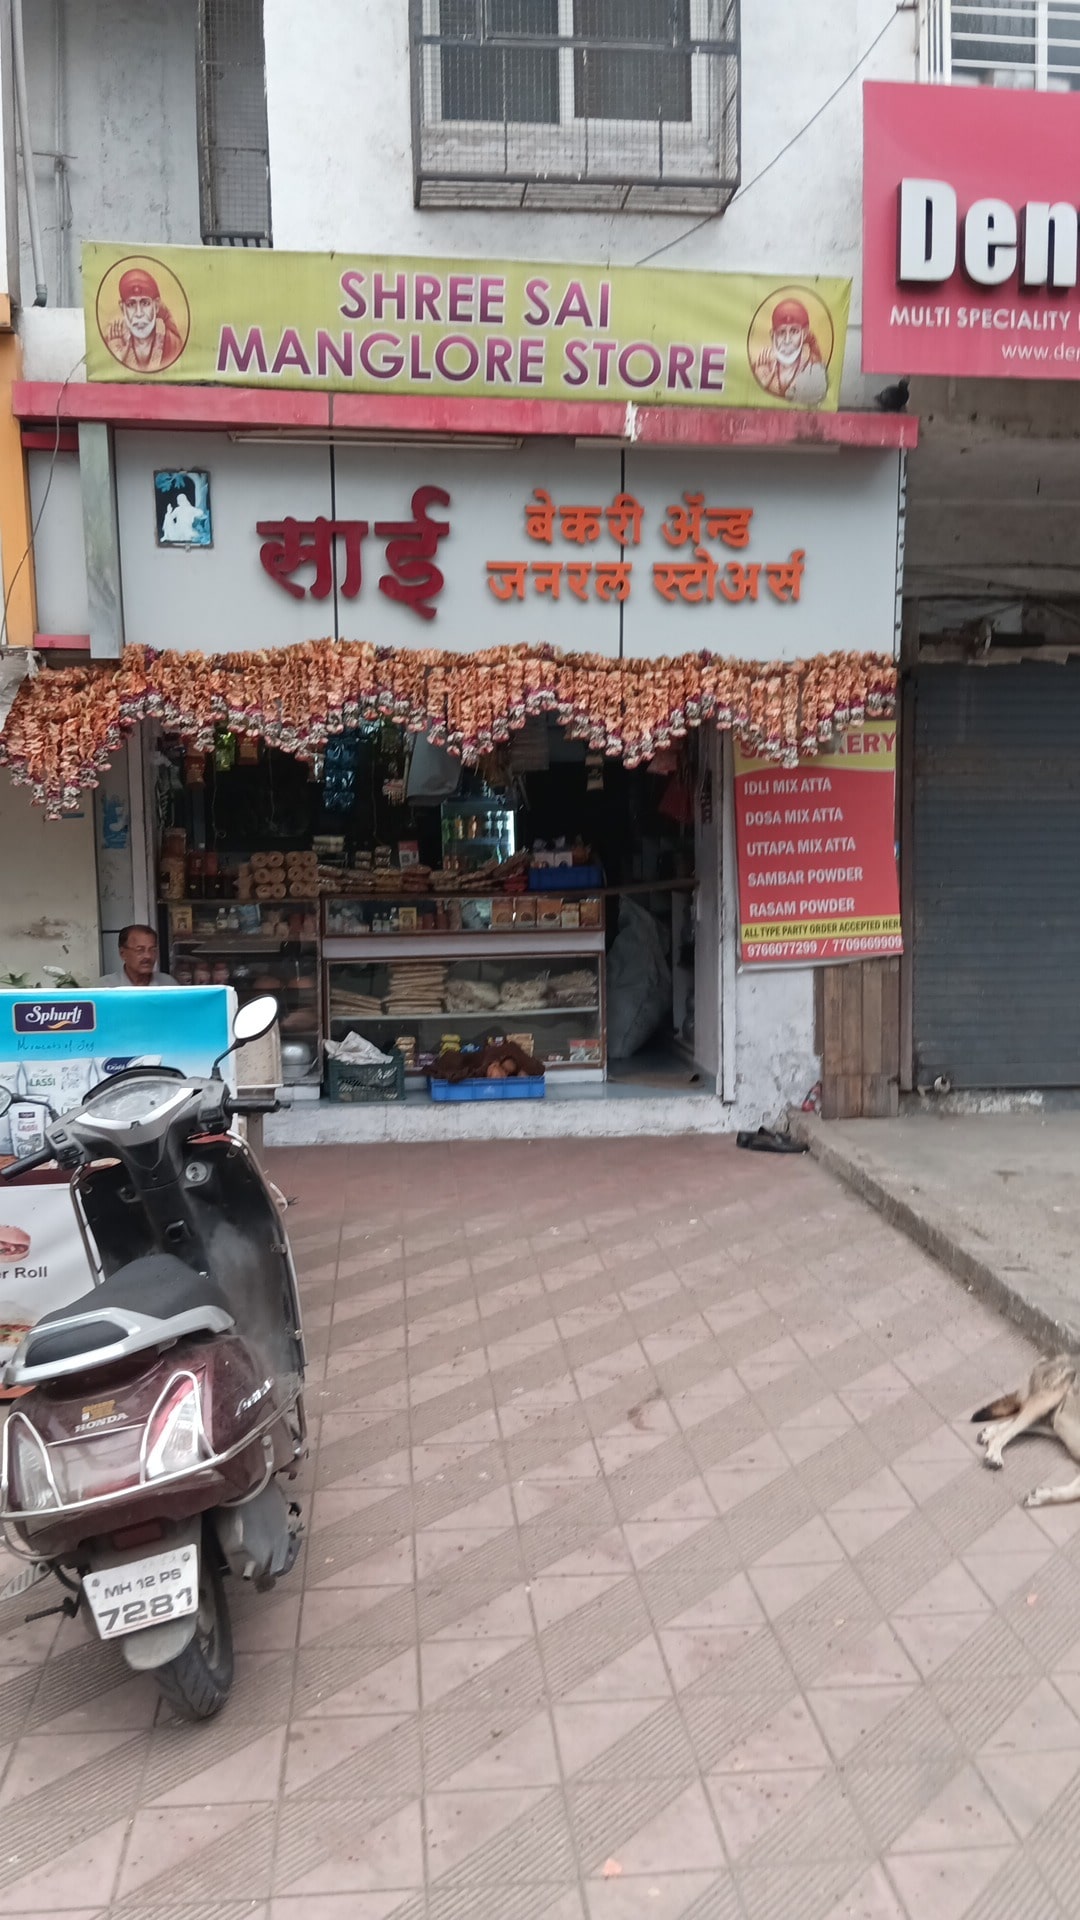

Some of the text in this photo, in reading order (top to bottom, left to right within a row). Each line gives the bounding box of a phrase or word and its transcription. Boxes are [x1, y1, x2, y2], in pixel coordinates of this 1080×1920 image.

[897, 177, 1078, 288] Den
[339, 270, 612, 328] SHREE SAI
[890, 305, 950, 328] MULTI
[957, 306, 1071, 331] SPECIALITY
[216, 324, 728, 392] MANGLORE STORE
[524, 488, 645, 545] बेकरी
[255, 485, 450, 621] साई
[486, 547, 806, 602] जनरल स्टोअर्स
[744, 777, 832, 796] IDLI MIX ATTA
[745, 806, 843, 826] DOSA MIX ATTA
[747, 836, 856, 857] UTTAPA MIX ATTA
[748, 866, 863, 887] SAMBAR POWDER
[750, 897, 855, 918] RASAM POWDER
[744, 928, 760, 938] ALL
[761, 927, 780, 937] TYPE
[782, 925, 808, 936] PARTY
[809, 923, 837, 934] ORDER
[839, 920, 881, 932] ACCEPTED
[747, 940, 818, 958] 9766077299
[25, 1005, 82, 1025] Sphurti
[30, 1078, 55, 1087] LASSI
[15, 1266, 48, 1279] Roll
[75, 1412, 128, 1433] HONDA
[104, 1567, 182, 1600] MH 12 PS
[98, 1586, 193, 1631] 7281
